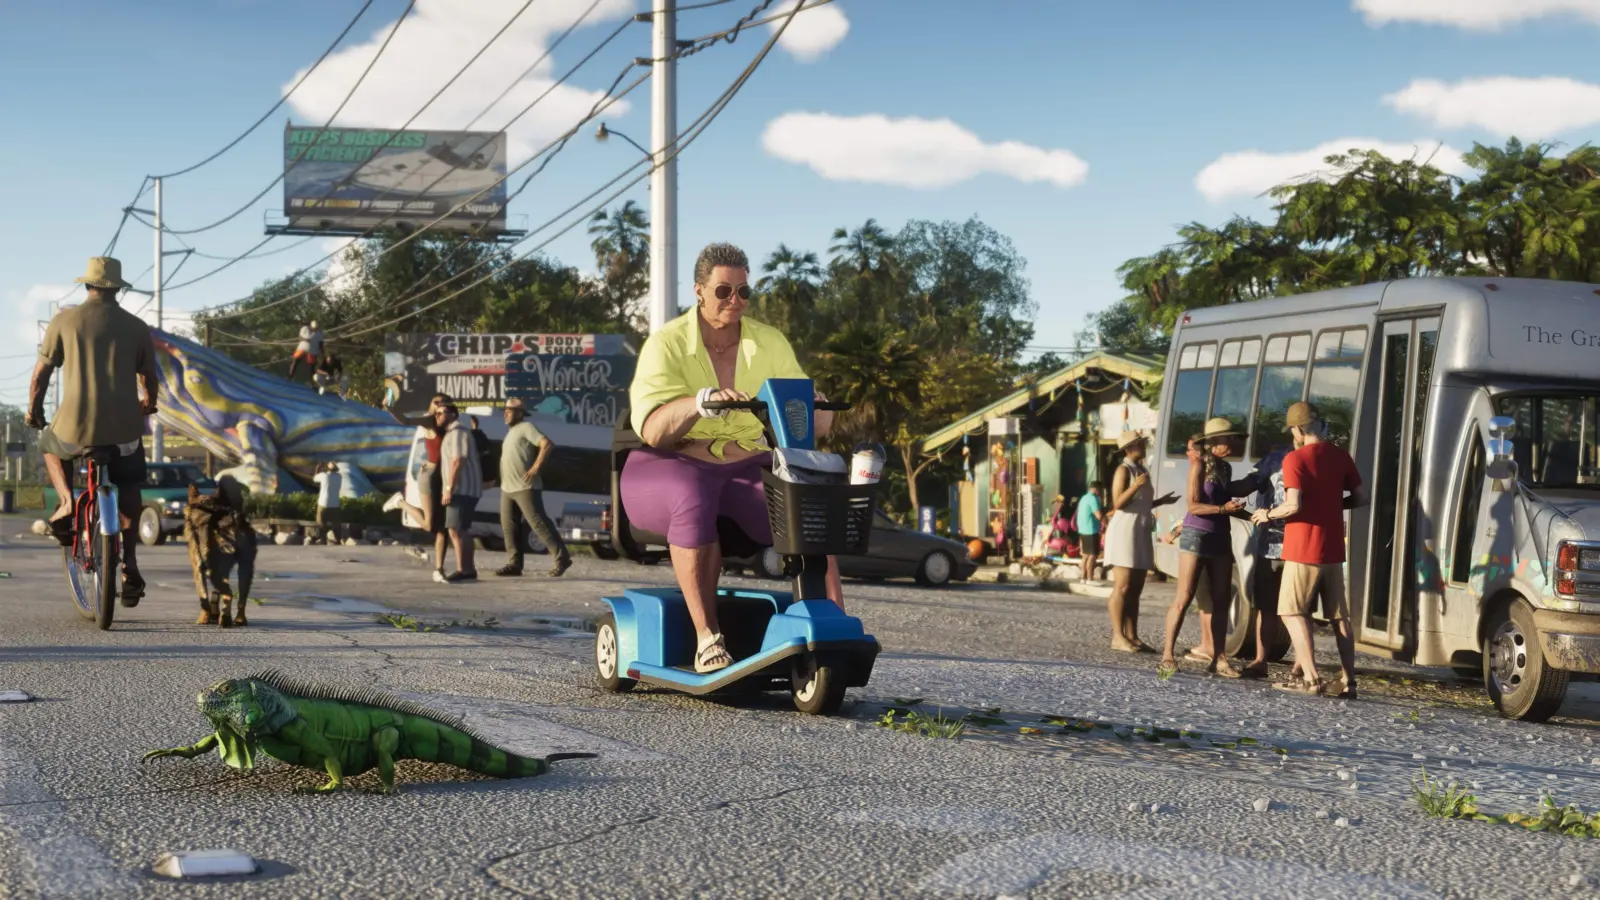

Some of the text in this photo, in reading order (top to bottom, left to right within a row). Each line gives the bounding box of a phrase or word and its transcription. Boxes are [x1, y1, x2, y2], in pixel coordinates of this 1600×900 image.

[290, 130, 427, 148] KEEPS BUSINESS
[439, 333, 541, 355] CHIP'S
[545, 336, 584, 346] BODY
[1522, 325, 1600, 347] The Gr
[545, 347, 584, 355] SHOP
[436, 375, 484, 399] HAVING
[487, 375, 497, 399] A
